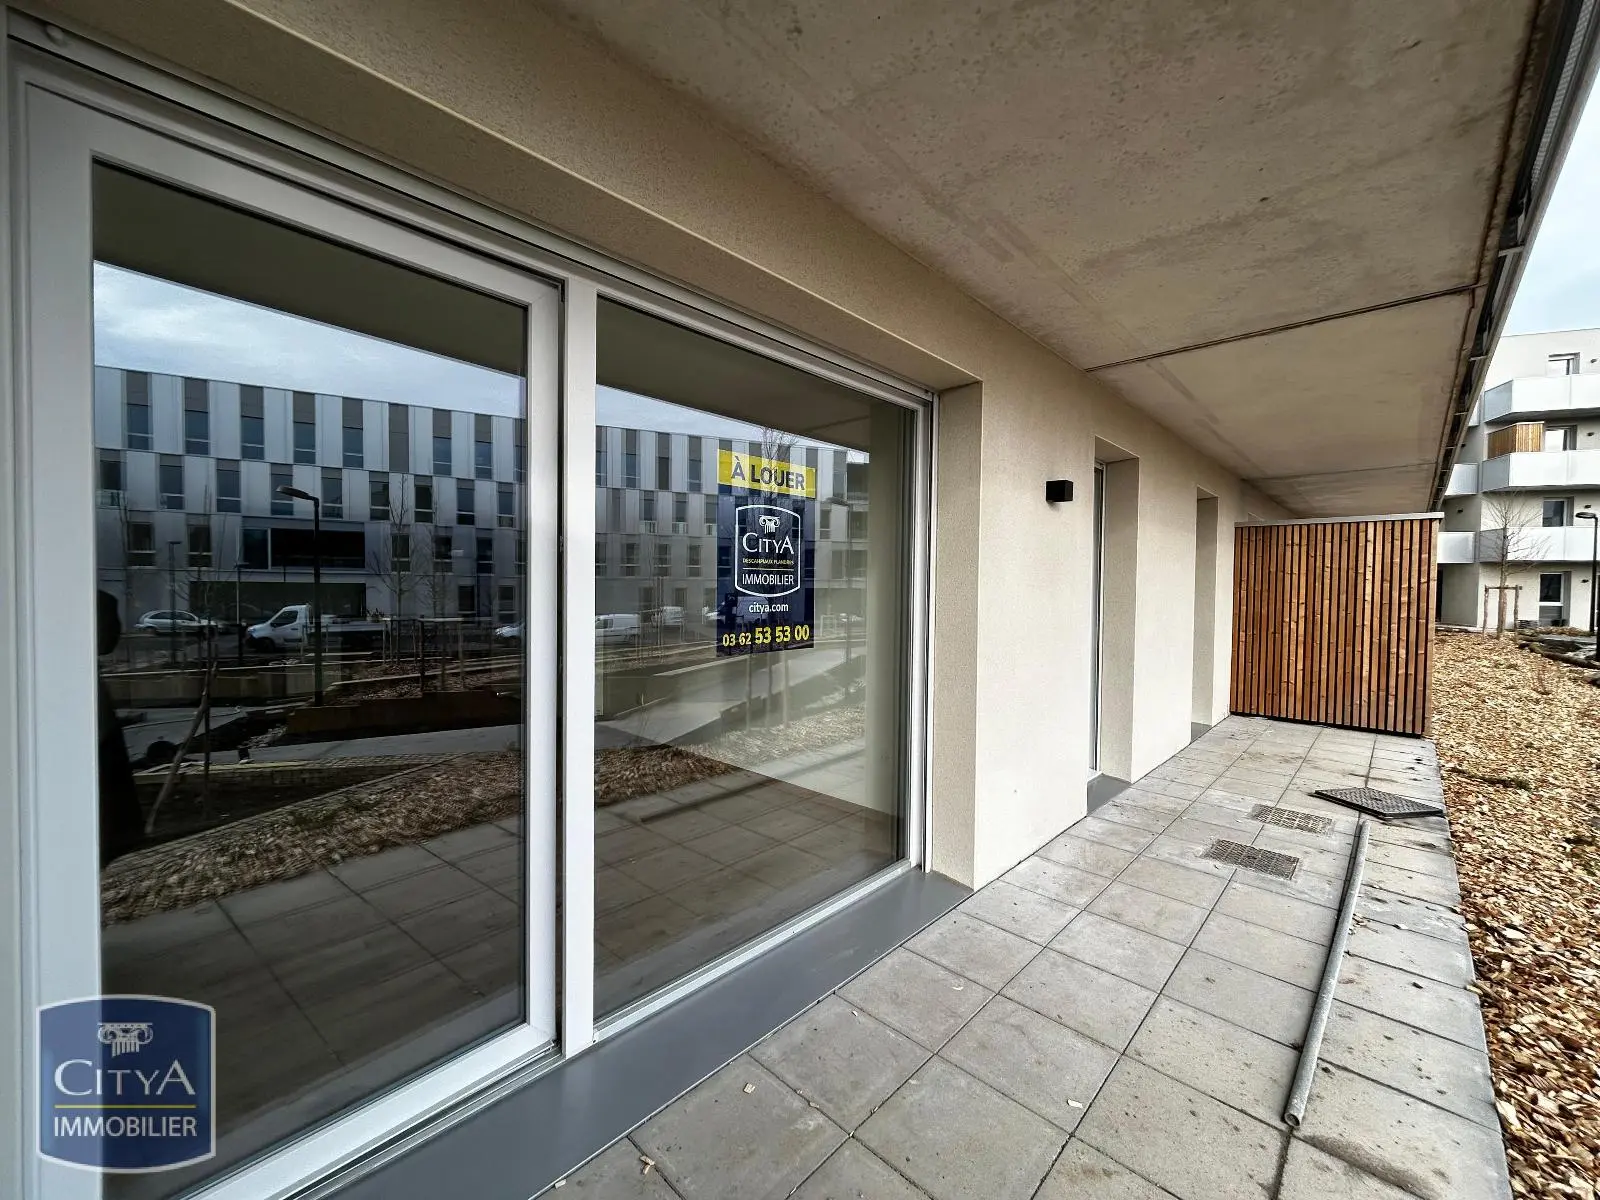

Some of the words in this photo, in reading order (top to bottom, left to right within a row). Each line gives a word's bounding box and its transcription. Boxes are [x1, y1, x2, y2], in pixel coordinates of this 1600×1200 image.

[731, 455, 746, 481] À
[751, 464, 805, 490] LOUER
[742, 573, 794, 585] IMMOBILIER
[748, 602, 789, 613] citya.com
[722, 633, 736, 647] 03
[739, 632, 752, 646] 62
[754, 626, 772, 644] 53
[775, 625, 791, 643] 53
[794, 624, 810, 641] 00
